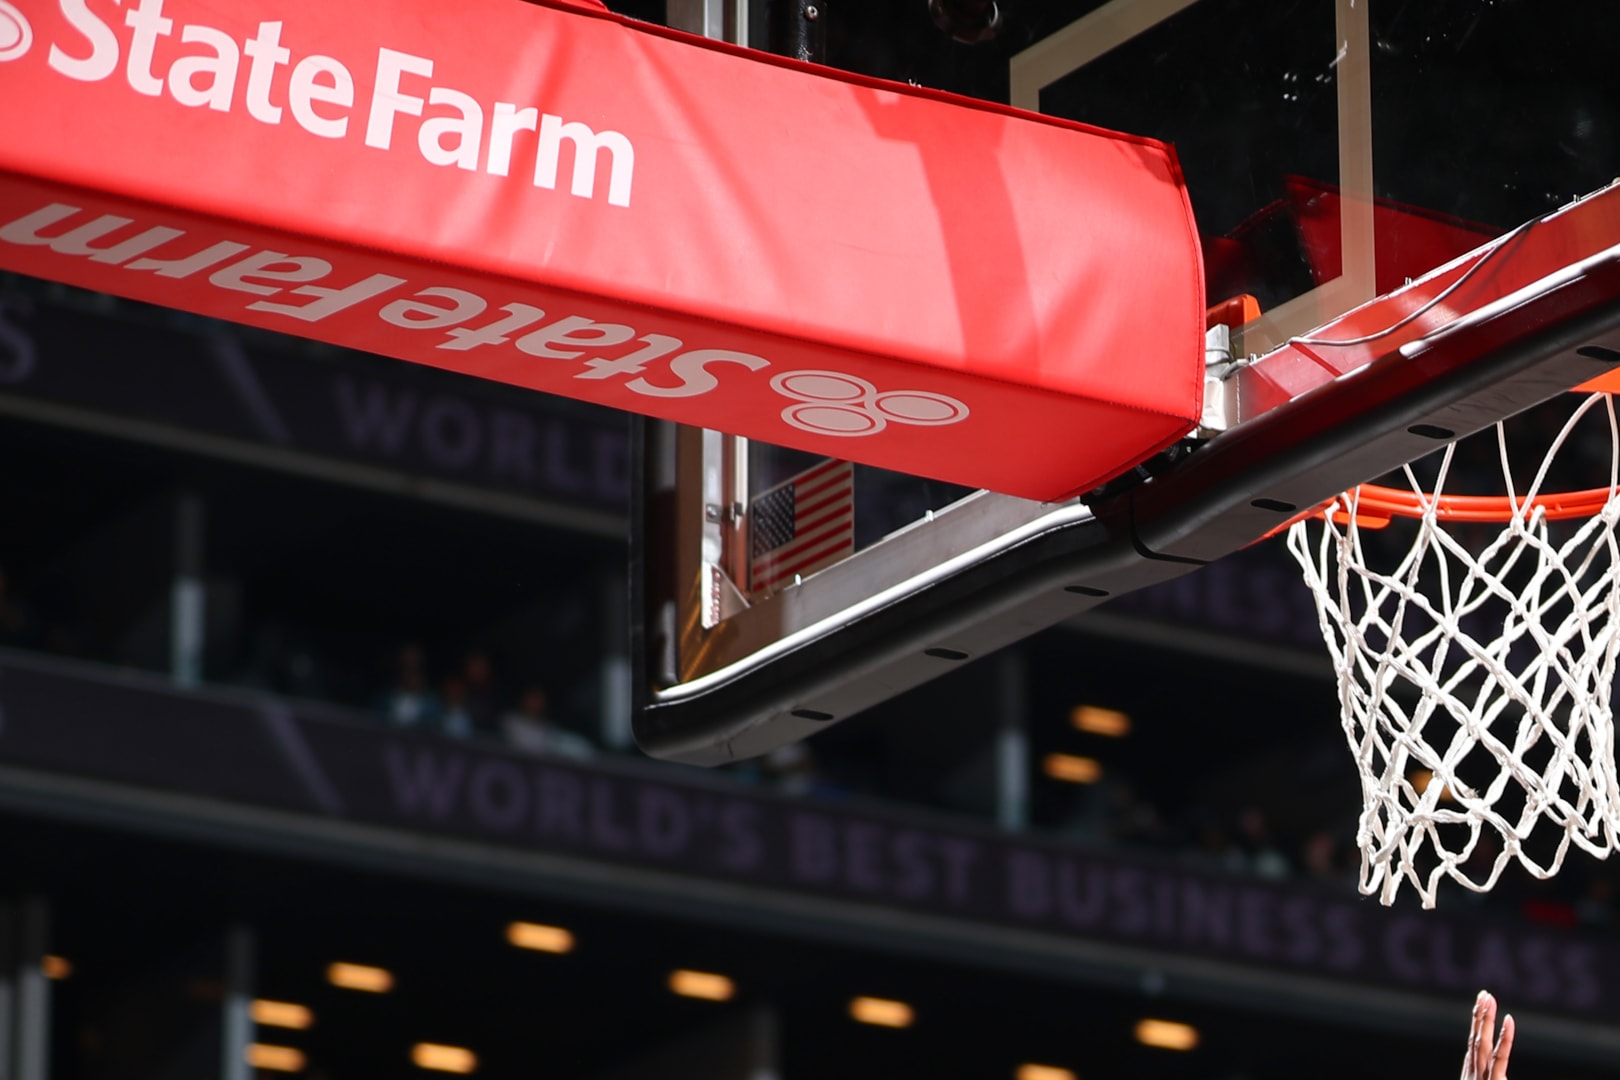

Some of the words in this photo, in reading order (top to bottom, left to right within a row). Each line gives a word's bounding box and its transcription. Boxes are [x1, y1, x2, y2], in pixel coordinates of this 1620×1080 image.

[385, 747, 762, 871] WORLD'S
[789, 813, 977, 906] BEST
[1007, 851, 1366, 973] BUSINESS
[1384, 916, 1600, 1007] CLASS
